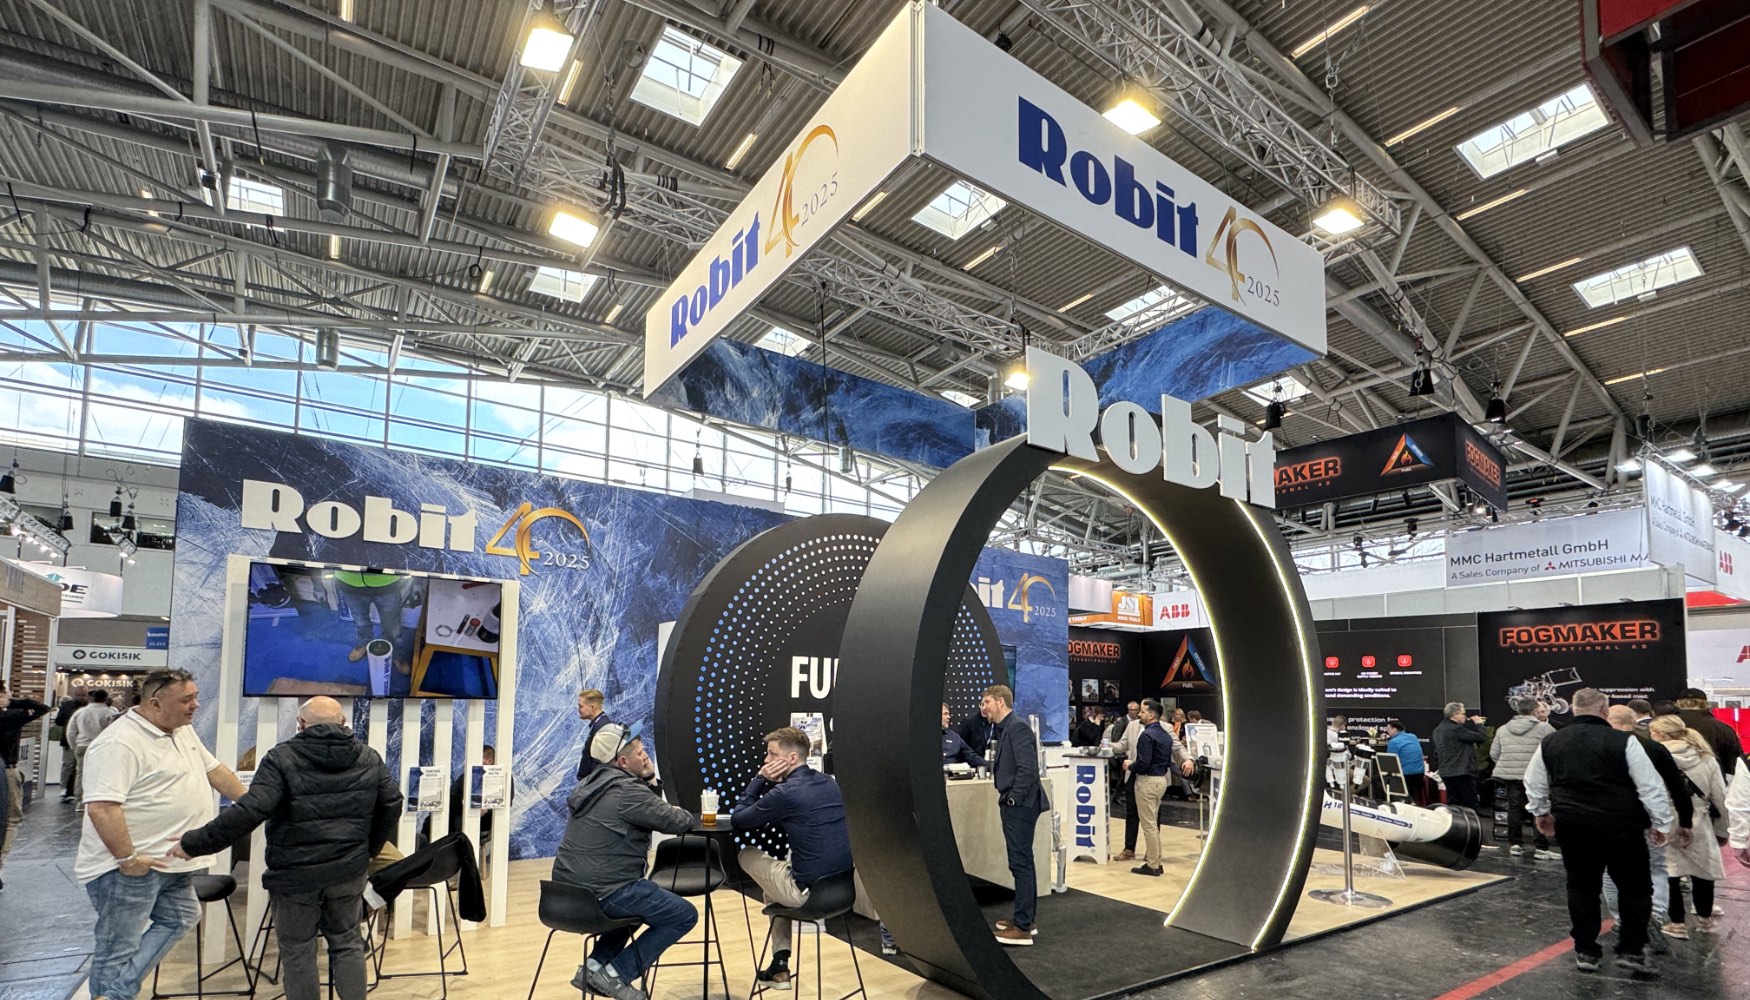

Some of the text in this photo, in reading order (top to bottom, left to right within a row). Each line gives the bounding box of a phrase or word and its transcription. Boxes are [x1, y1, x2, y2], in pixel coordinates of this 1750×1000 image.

[1018, 95, 1199, 259] Robit
[801, 171, 839, 226] 2025
[670, 211, 761, 349] Robit
[1247, 276, 1280, 307] 2025
[1026, 345, 1277, 509] Robit
[241, 479, 478, 552] Robit
[543, 551, 590, 569] 2025
[1450, 539, 1609, 567] MMC Hartmetall GmbH
[1451, 571, 1458, 580] A
[1459, 569, 1484, 579] Sales
[1485, 565, 1530, 577] Company
[1531, 564, 1540, 572] of
[1558, 555, 1627, 570] MITSUBISHI
[1718, 550, 1734, 575] ABB
[1034, 605, 1057, 617] 2025
[1160, 603, 1190, 620] ABB
[1501, 621, 1660, 647] FOGMAKER
[1511, 644, 1620, 654] INTERNATIONAL
[790, 656, 840, 700] FU
[1076, 765, 1096, 848] Robit
